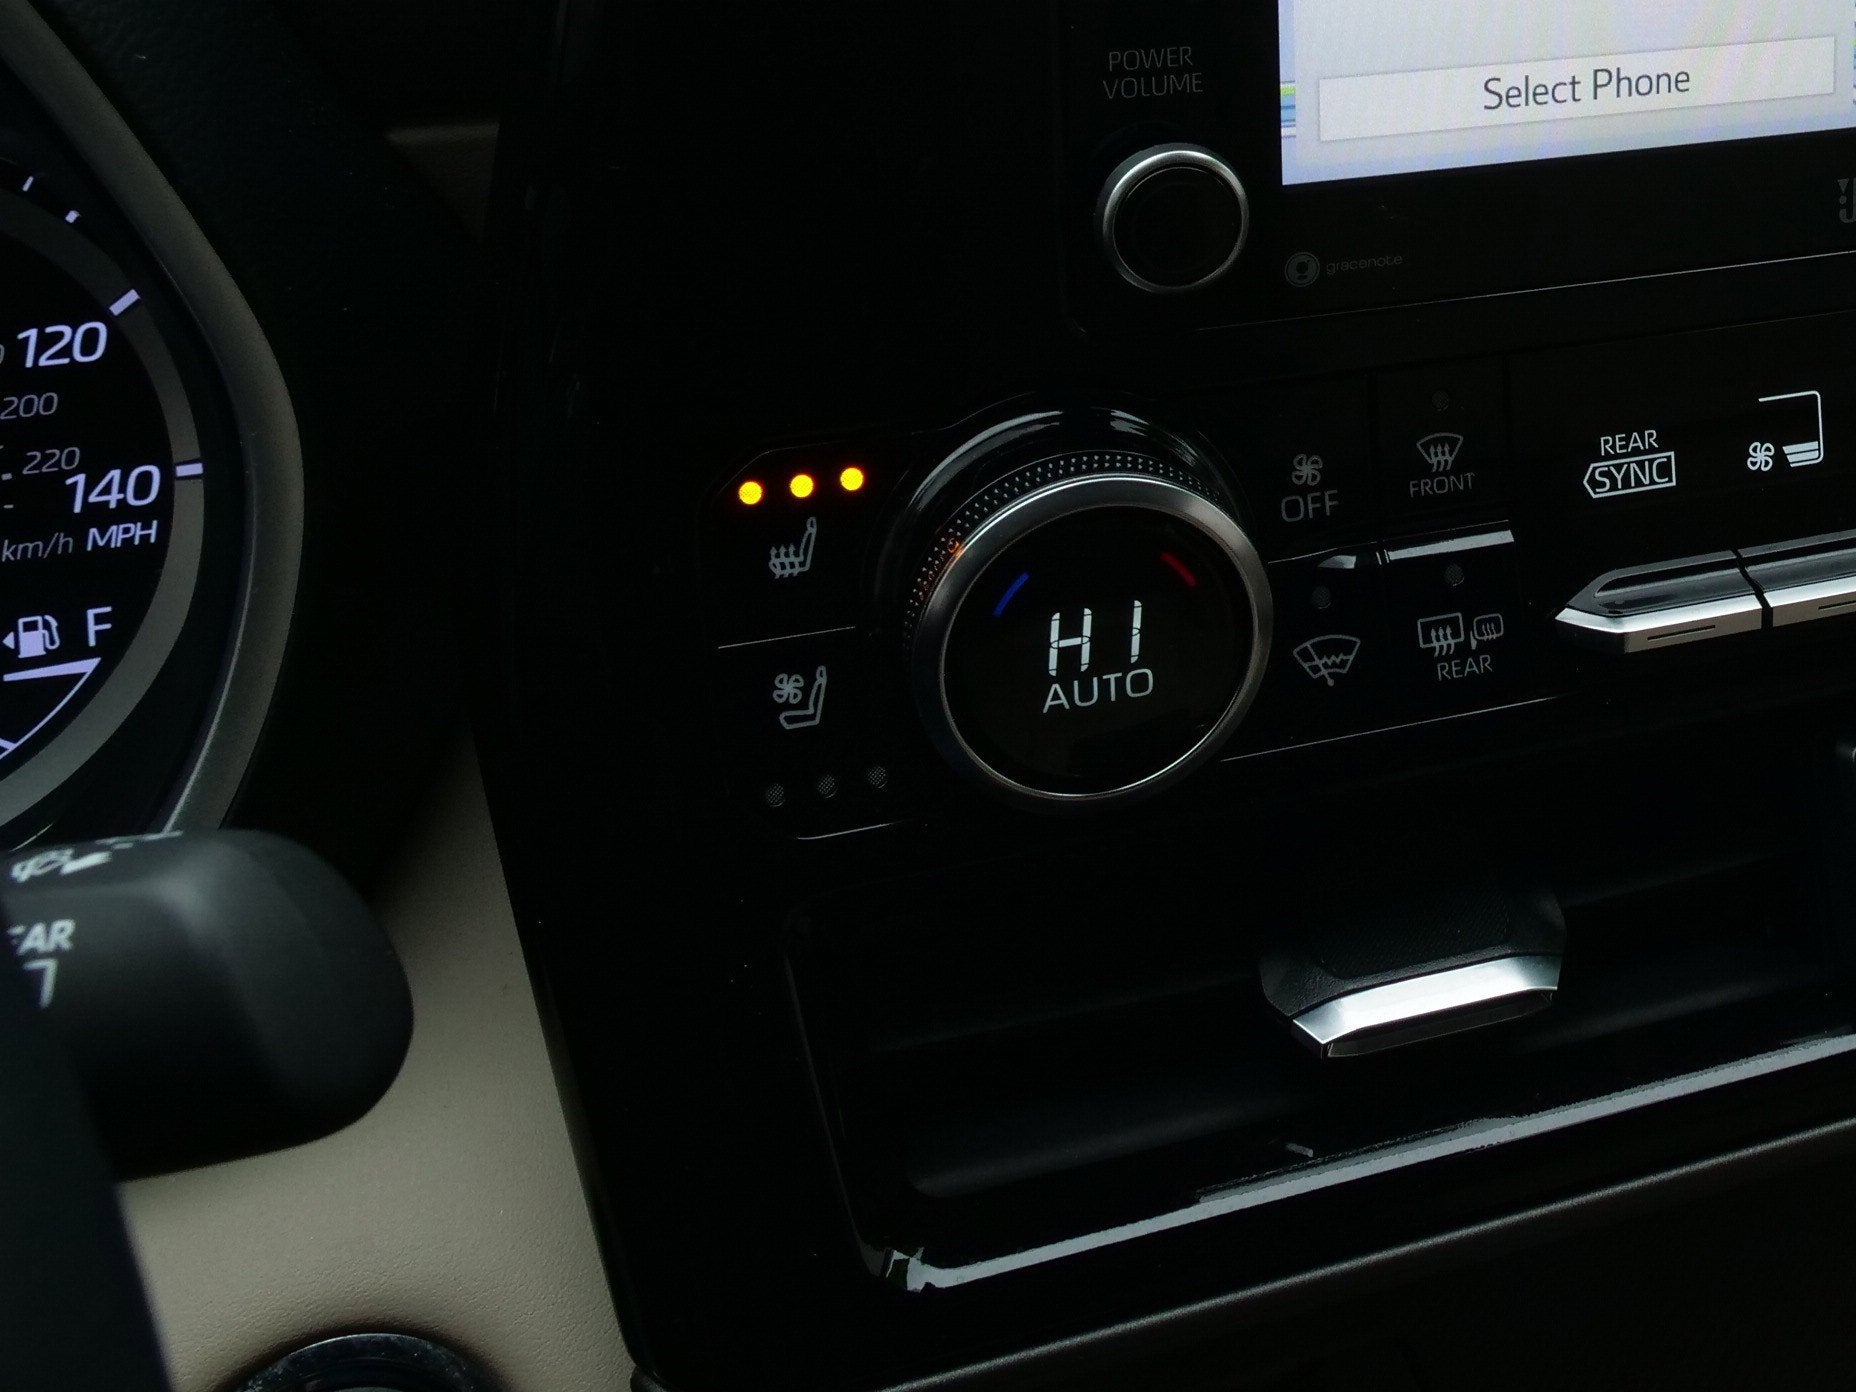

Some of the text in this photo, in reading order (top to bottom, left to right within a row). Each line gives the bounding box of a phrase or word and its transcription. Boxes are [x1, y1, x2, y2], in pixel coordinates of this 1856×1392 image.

[1108, 46, 1194, 72] POWER
[1103, 72, 1204, 101] VOLUME
[1483, 67, 1692, 112] Select Phone
[15, 321, 109, 369] 120
[0, 391, 58, 420] 200
[1600, 428, 1660, 456] REAR
[21, 446, 81, 476] 220
[1594, 456, 1670, 494] SYNC
[64, 464, 162, 515] 140
[1409, 471, 1475, 498] FRONT
[1280, 489, 1339, 522] OFF
[2, 519, 157, 562] km/h MPH
[85, 606, 112, 648] F
[1436, 654, 1494, 682] REAR
[1042, 667, 1154, 715] AUTO
